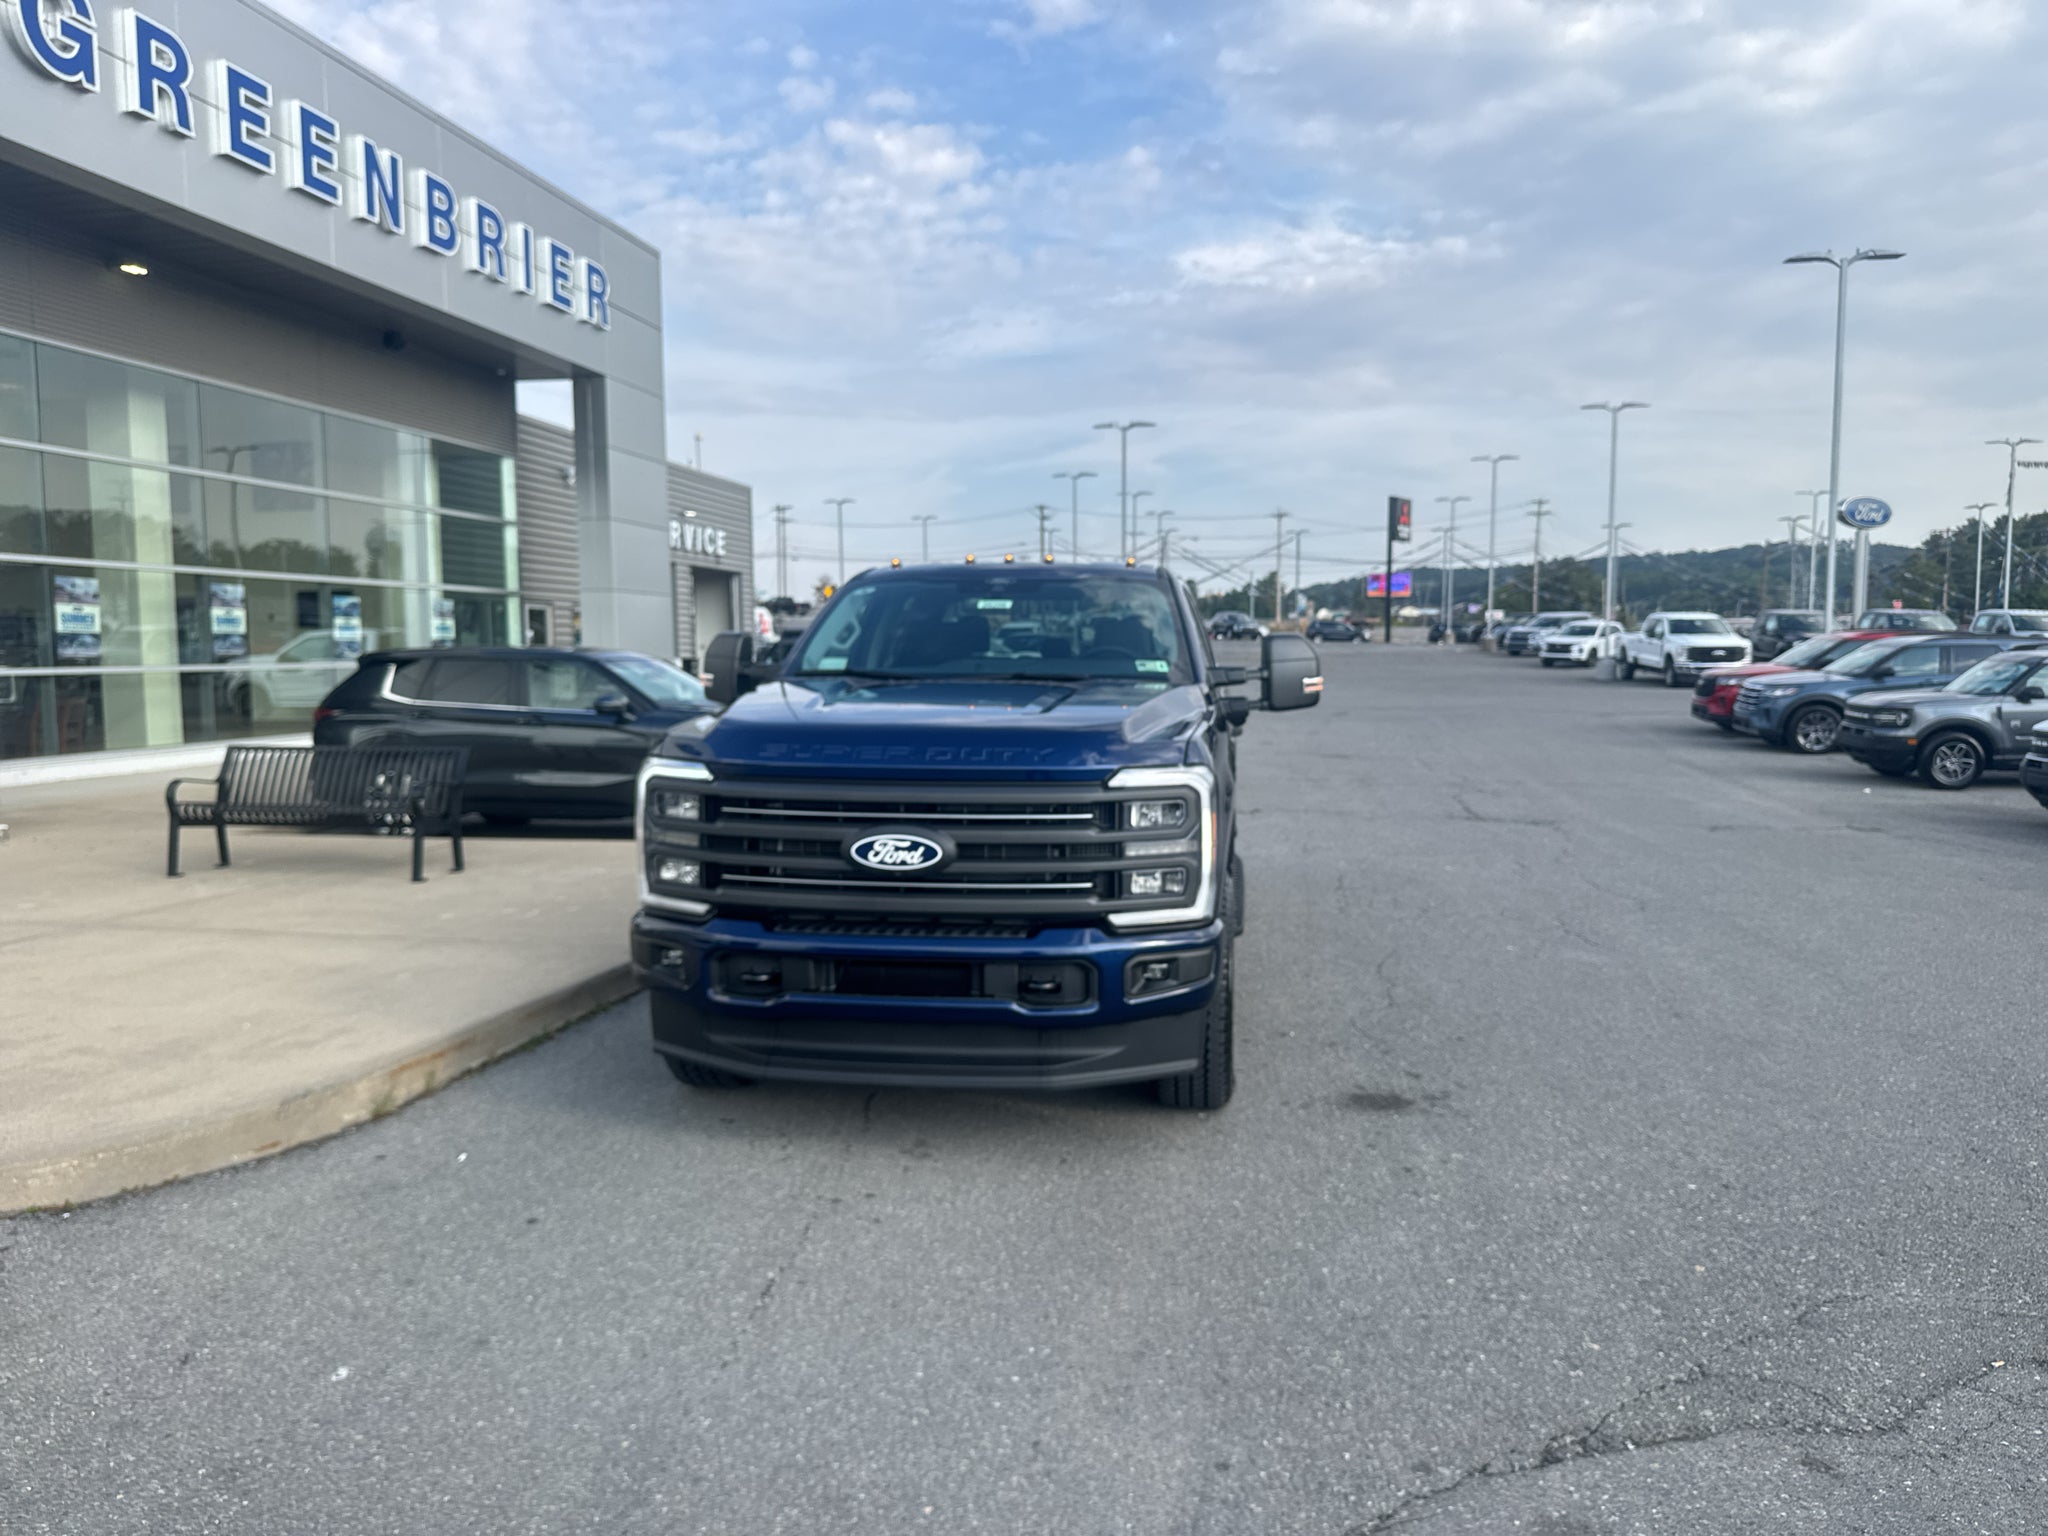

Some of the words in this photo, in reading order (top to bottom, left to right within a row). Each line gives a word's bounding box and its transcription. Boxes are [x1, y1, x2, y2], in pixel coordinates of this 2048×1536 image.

[8, 0, 611, 331] GREENBRIER
[1855, 503, 1884, 521] Ford
[758, 742, 912, 761] SUPER
[924, 746, 1056, 762] DUTY
[867, 839, 925, 865] Ford
